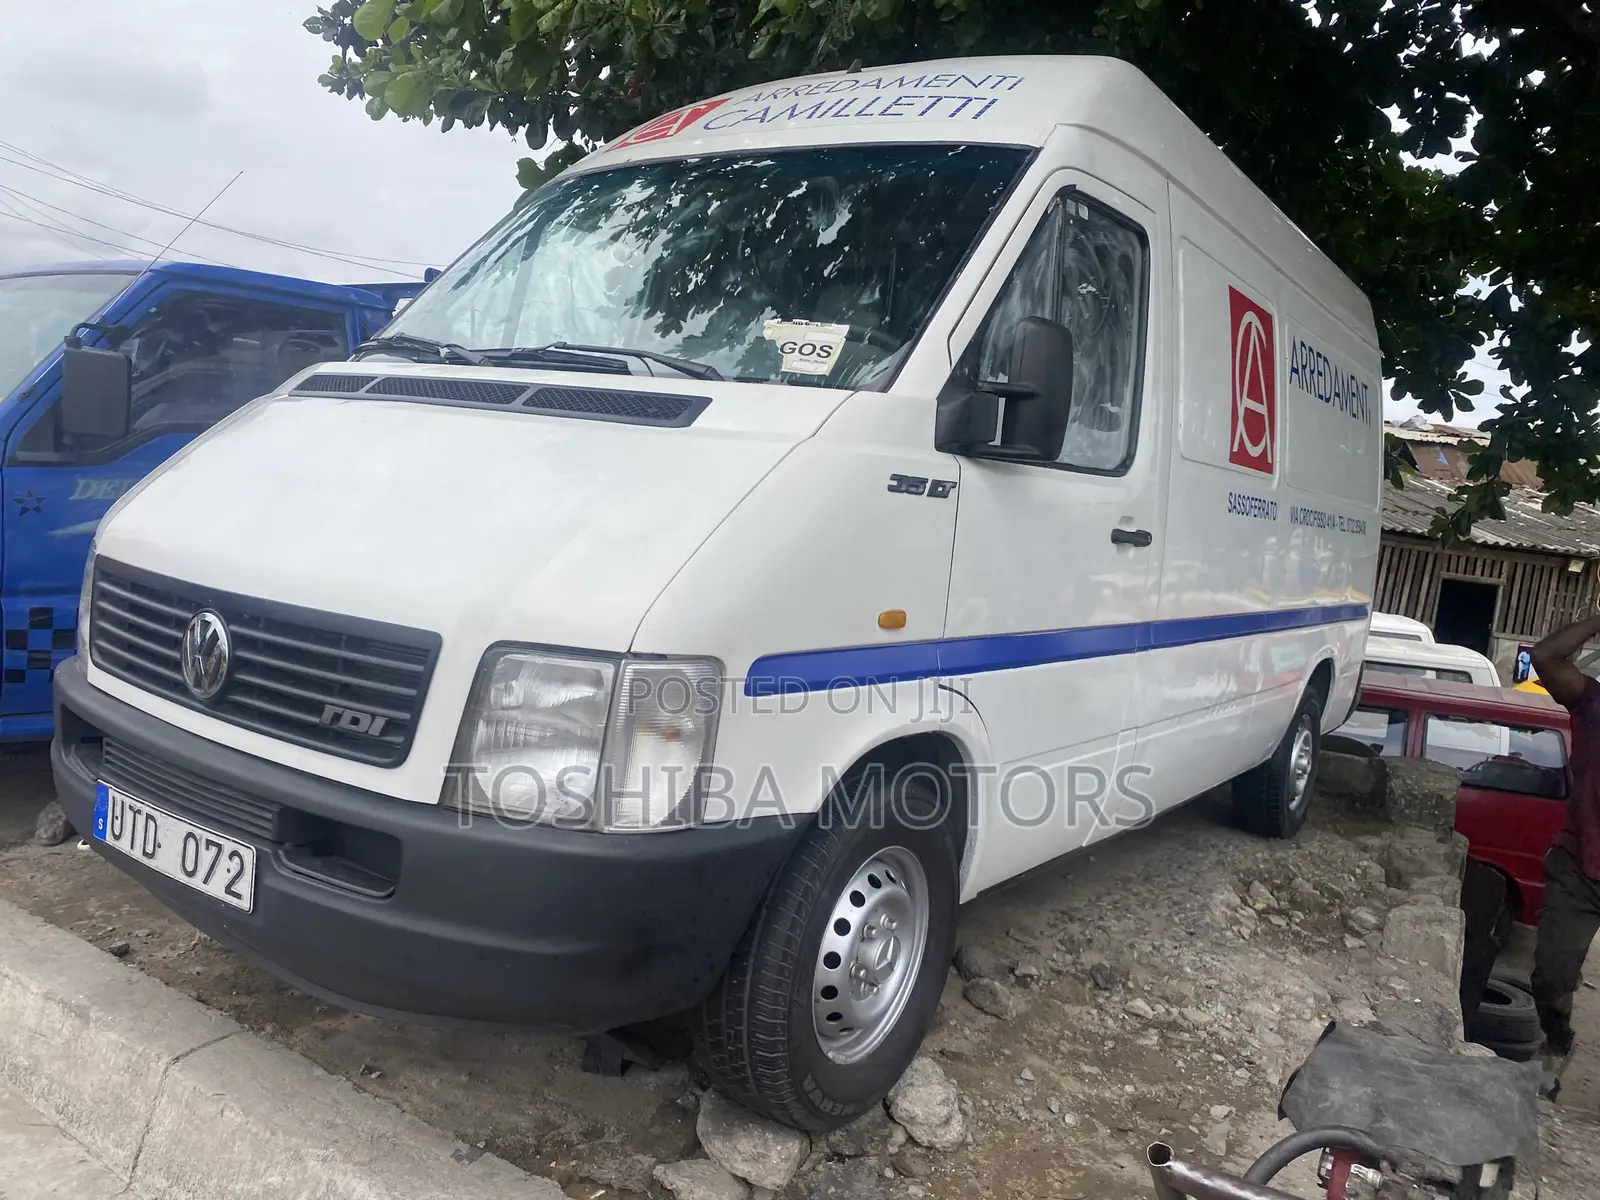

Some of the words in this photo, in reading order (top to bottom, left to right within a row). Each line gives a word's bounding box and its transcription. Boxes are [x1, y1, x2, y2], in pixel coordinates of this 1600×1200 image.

[733, 73, 1025, 105] ARREDAMENTI
[703, 94, 999, 131] CAMILLETTI
[779, 341, 834, 359] GOS
[1227, 491, 1278, 521] SASSOFERRATO
[318, 704, 390, 738] TDI
[97, 818, 105, 830] S
[110, 795, 159, 860] UTD
[180, 830, 246, 900] 072
